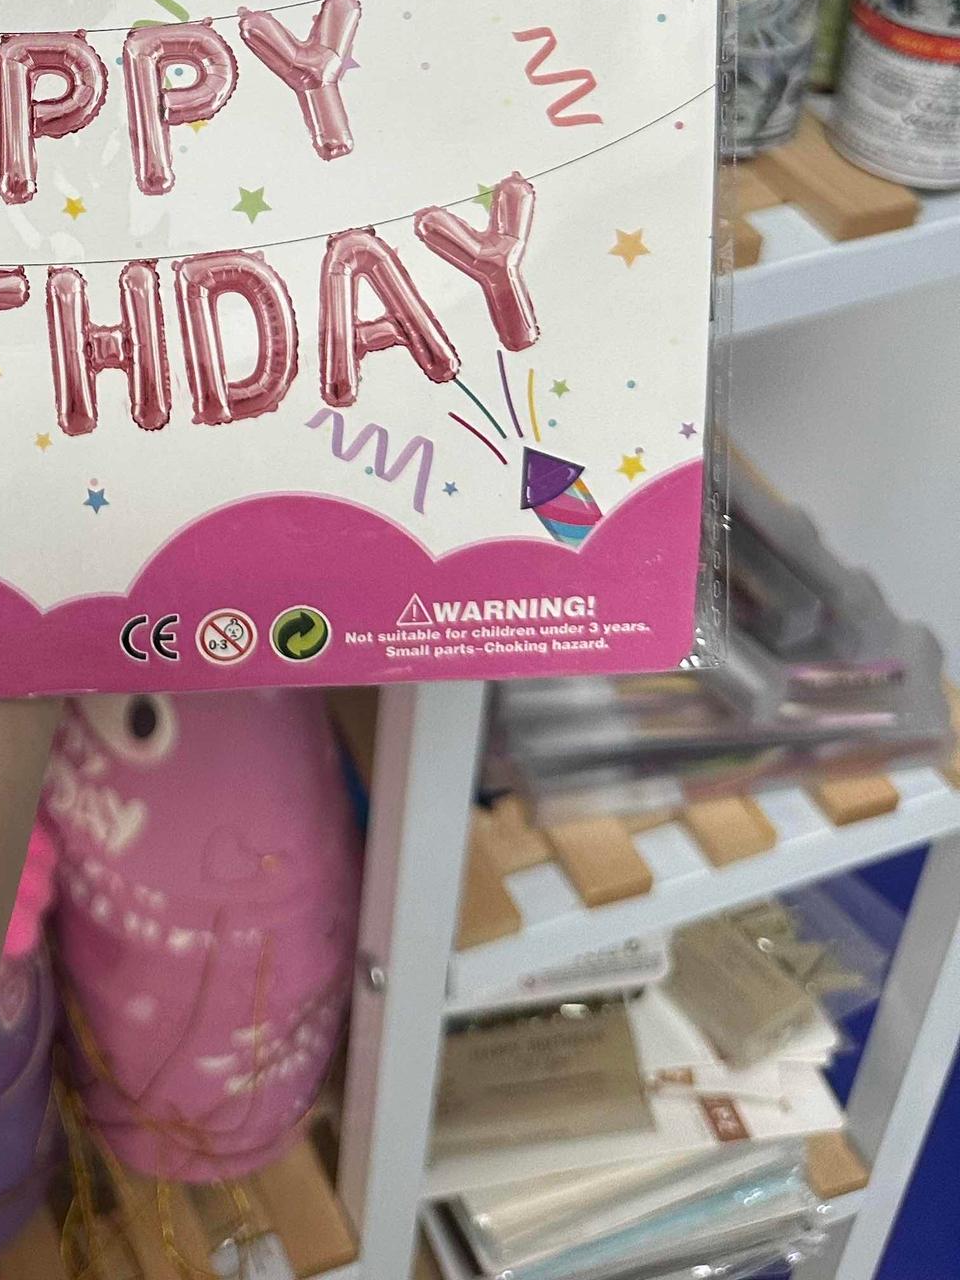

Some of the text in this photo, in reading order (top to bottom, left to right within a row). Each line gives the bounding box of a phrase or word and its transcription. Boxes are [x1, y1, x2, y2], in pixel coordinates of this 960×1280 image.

[432, 595, 596, 623] WARNING!
[345, 620, 650, 644] Not suitable for children under 3 years.
[385, 644, 430, 658] Small
[552, 637, 609, 651] hazard.
